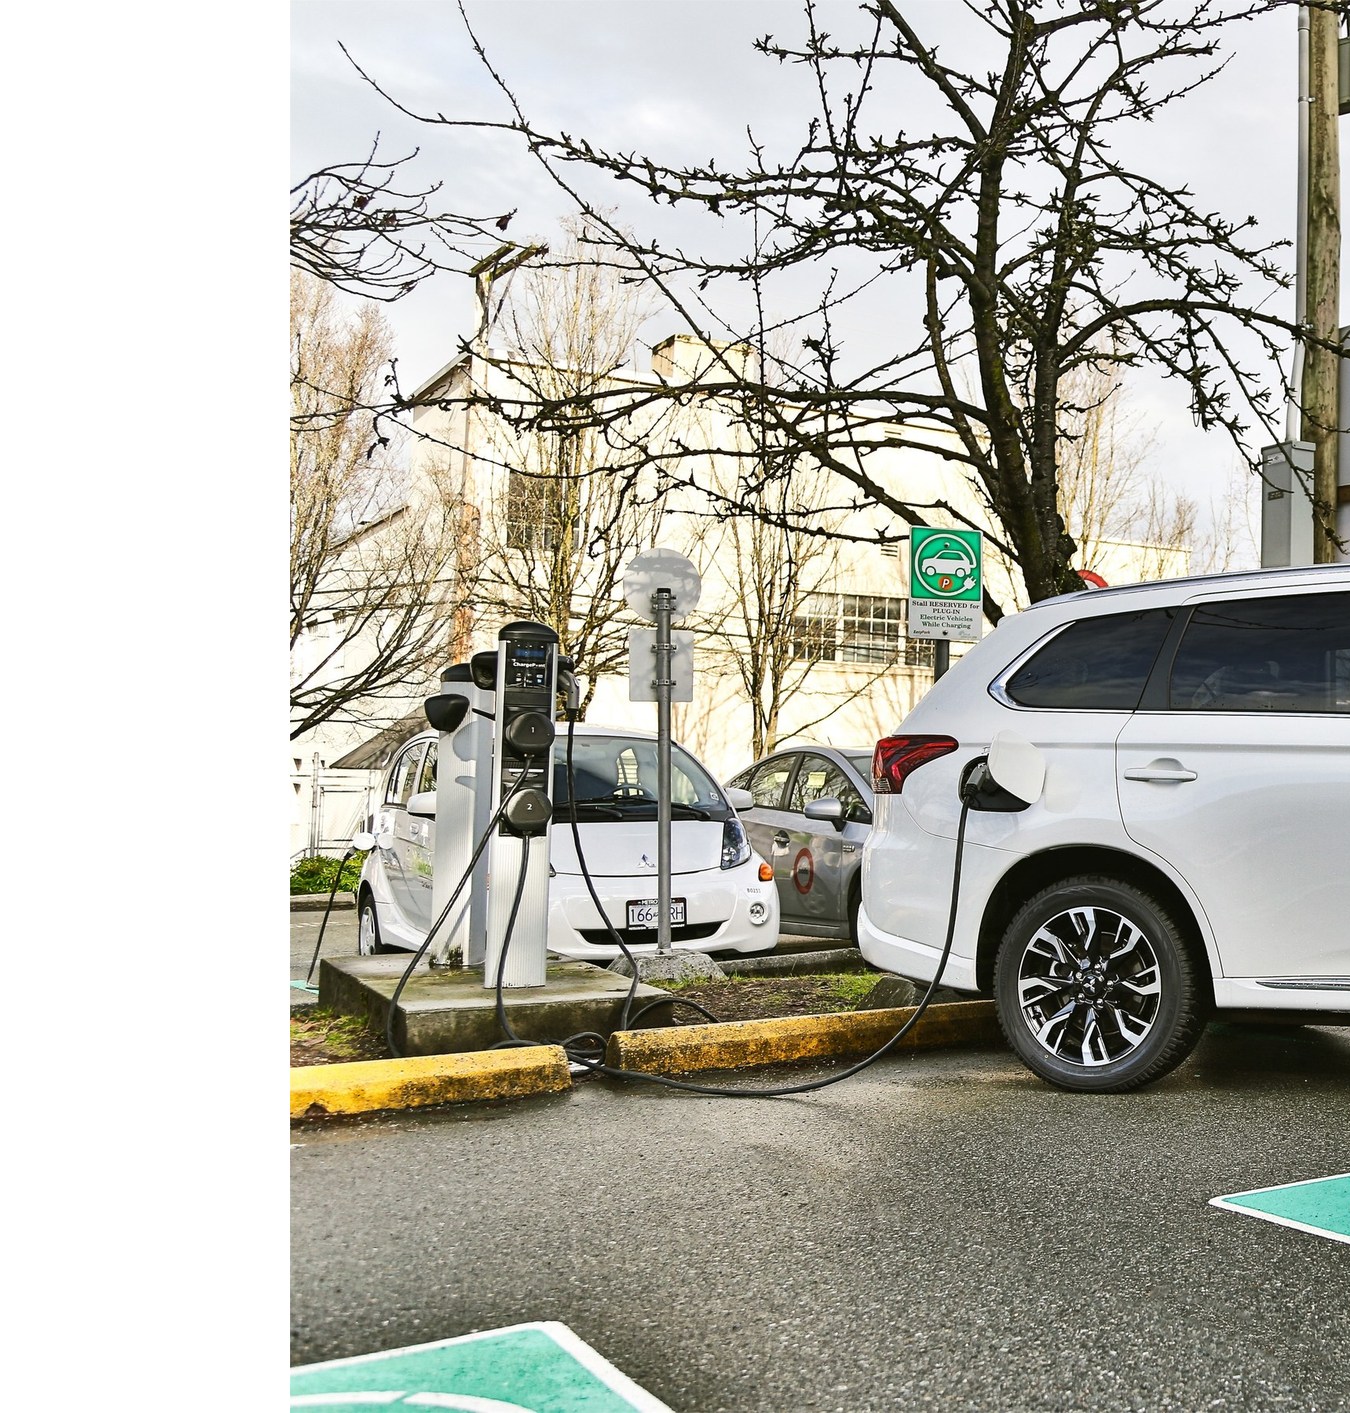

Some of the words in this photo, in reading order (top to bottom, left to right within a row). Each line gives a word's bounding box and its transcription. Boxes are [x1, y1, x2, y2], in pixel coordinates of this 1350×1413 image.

[942, 578, 950, 588] P
[929, 601, 968, 609] RESERVED
[527, 803, 533, 811] 2
